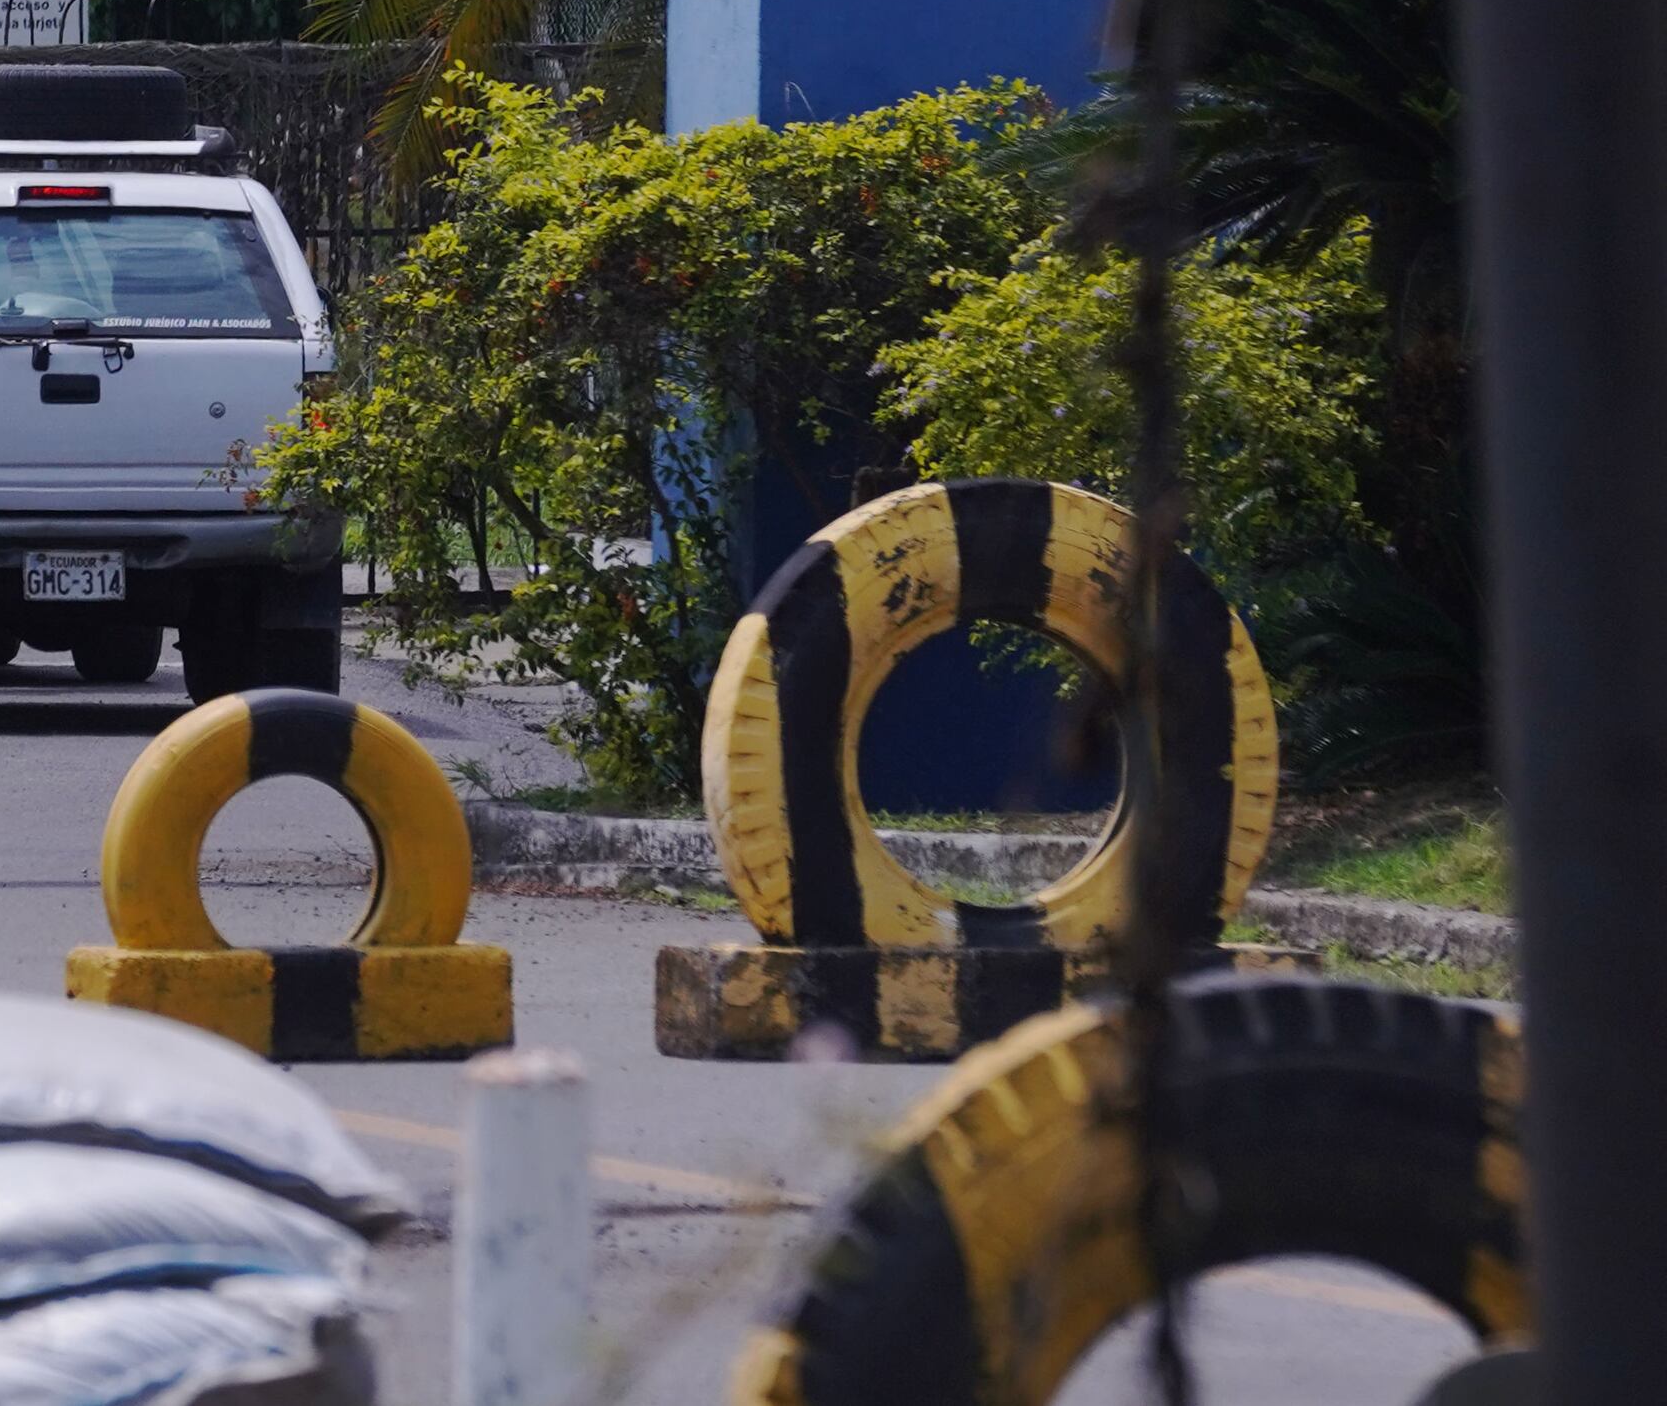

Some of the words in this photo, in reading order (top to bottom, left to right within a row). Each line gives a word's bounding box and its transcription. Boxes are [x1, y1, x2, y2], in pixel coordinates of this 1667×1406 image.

[58, 1, 66, 13] y
[103, 317, 142, 327] ESTUDIO
[221, 319, 271, 329] ASOCIADOS
[50, 557, 97, 568] ECUADOR
